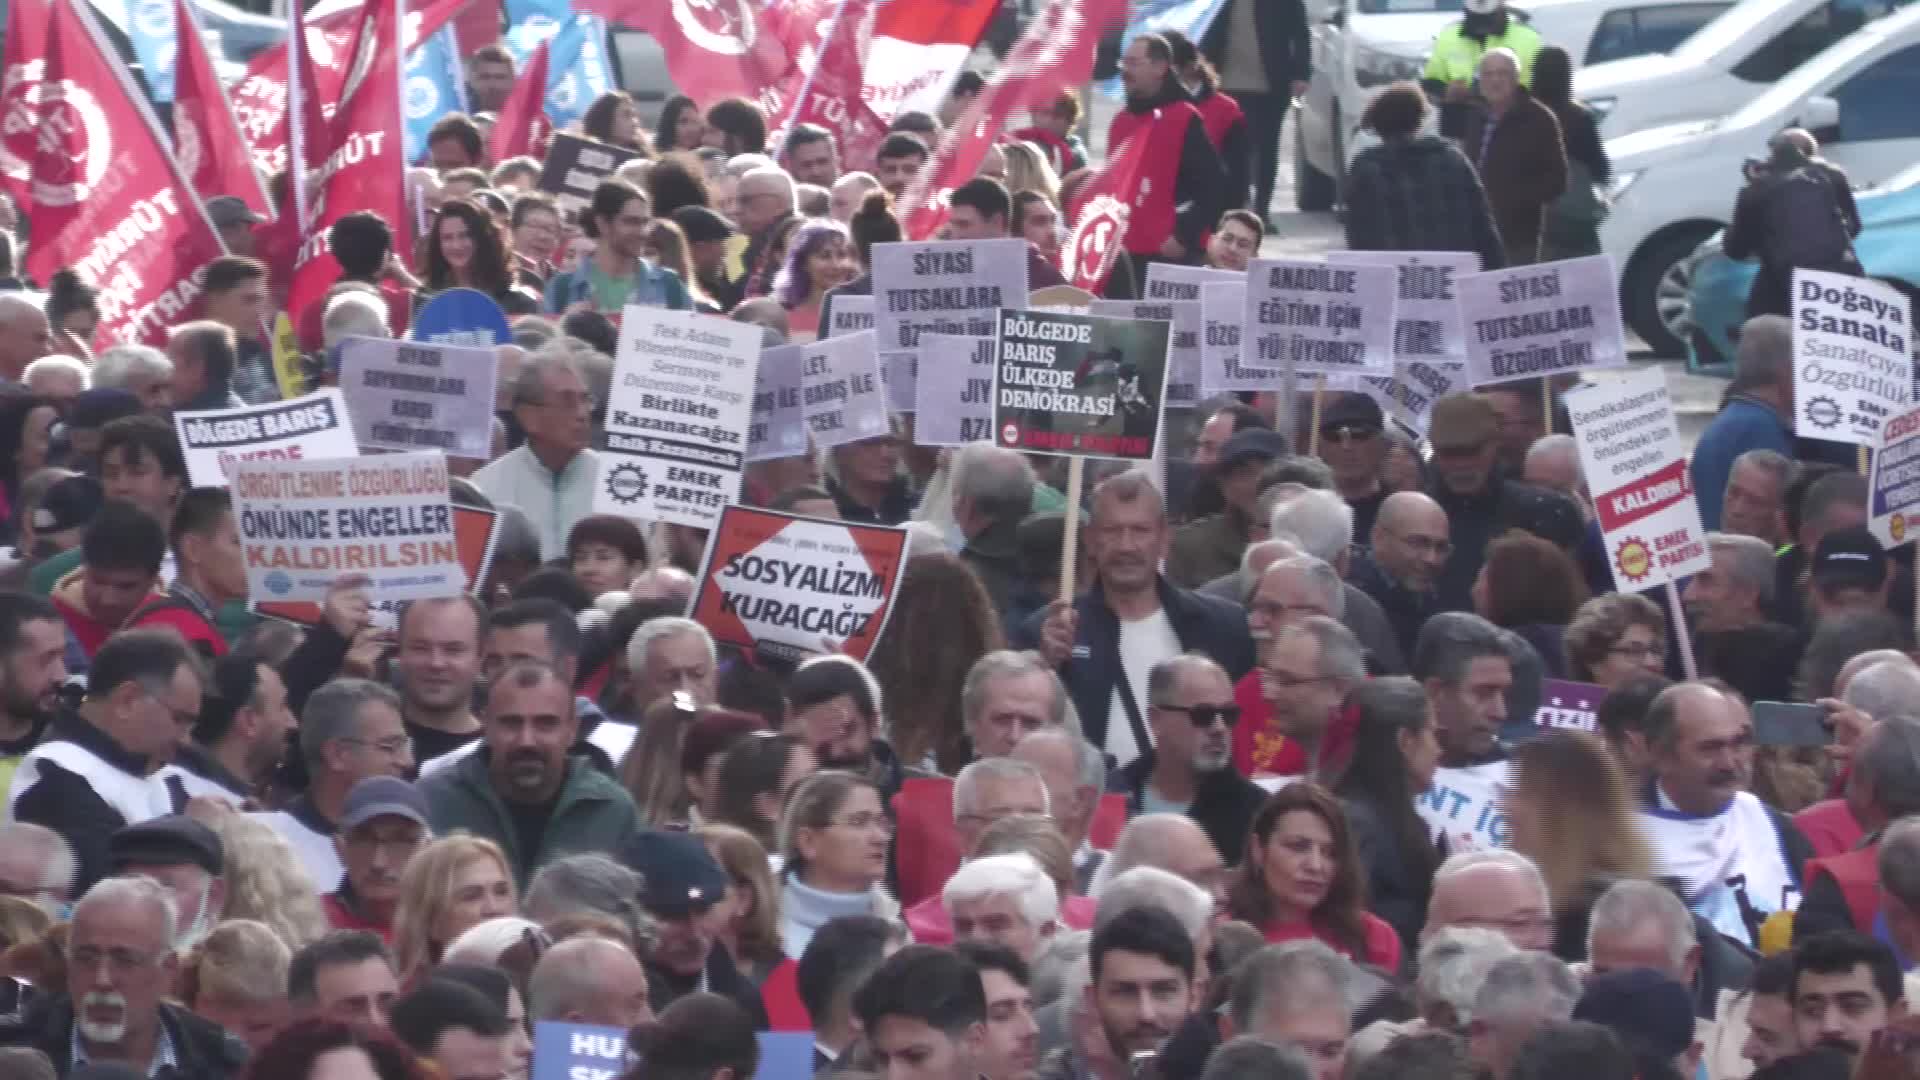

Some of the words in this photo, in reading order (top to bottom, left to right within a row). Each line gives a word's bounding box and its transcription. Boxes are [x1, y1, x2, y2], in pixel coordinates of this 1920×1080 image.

[912, 247, 975, 276] SİYASİ
[887, 286, 1001, 313] TUTSAKLARA
[1499, 268, 1561, 304] SİYASİ
[1800, 280, 1903, 323] Doğaya
[1003, 315, 1092, 344] BÖLGEDE
[1326, 300, 1362, 336] İÇİN
[1474, 304, 1595, 344] TUTSAKLARA
[1800, 307, 1905, 353] Sanata
[1003, 342, 1057, 368] BARIŞ
[1257, 332, 1366, 365] YÜÜYORUZ!
[1801, 337, 1907, 378] Sanatçıya
[1002, 362, 1076, 390] ÜLKEDE
[640, 393, 720, 420] Birlikte
[1000, 388, 1116, 416] DEMOKRASİ
[613, 410, 741, 444] Kazanacağız
[666, 466, 723, 489] EMEK
[241, 503, 332, 539] ÖNÜNDE
[335, 504, 450, 538] ENGELLER
[247, 541, 457, 570] KALDIRILSIN
[723, 553, 888, 600] SOSYALİZMİ
[720, 590, 873, 639] KURACAĞIZ
